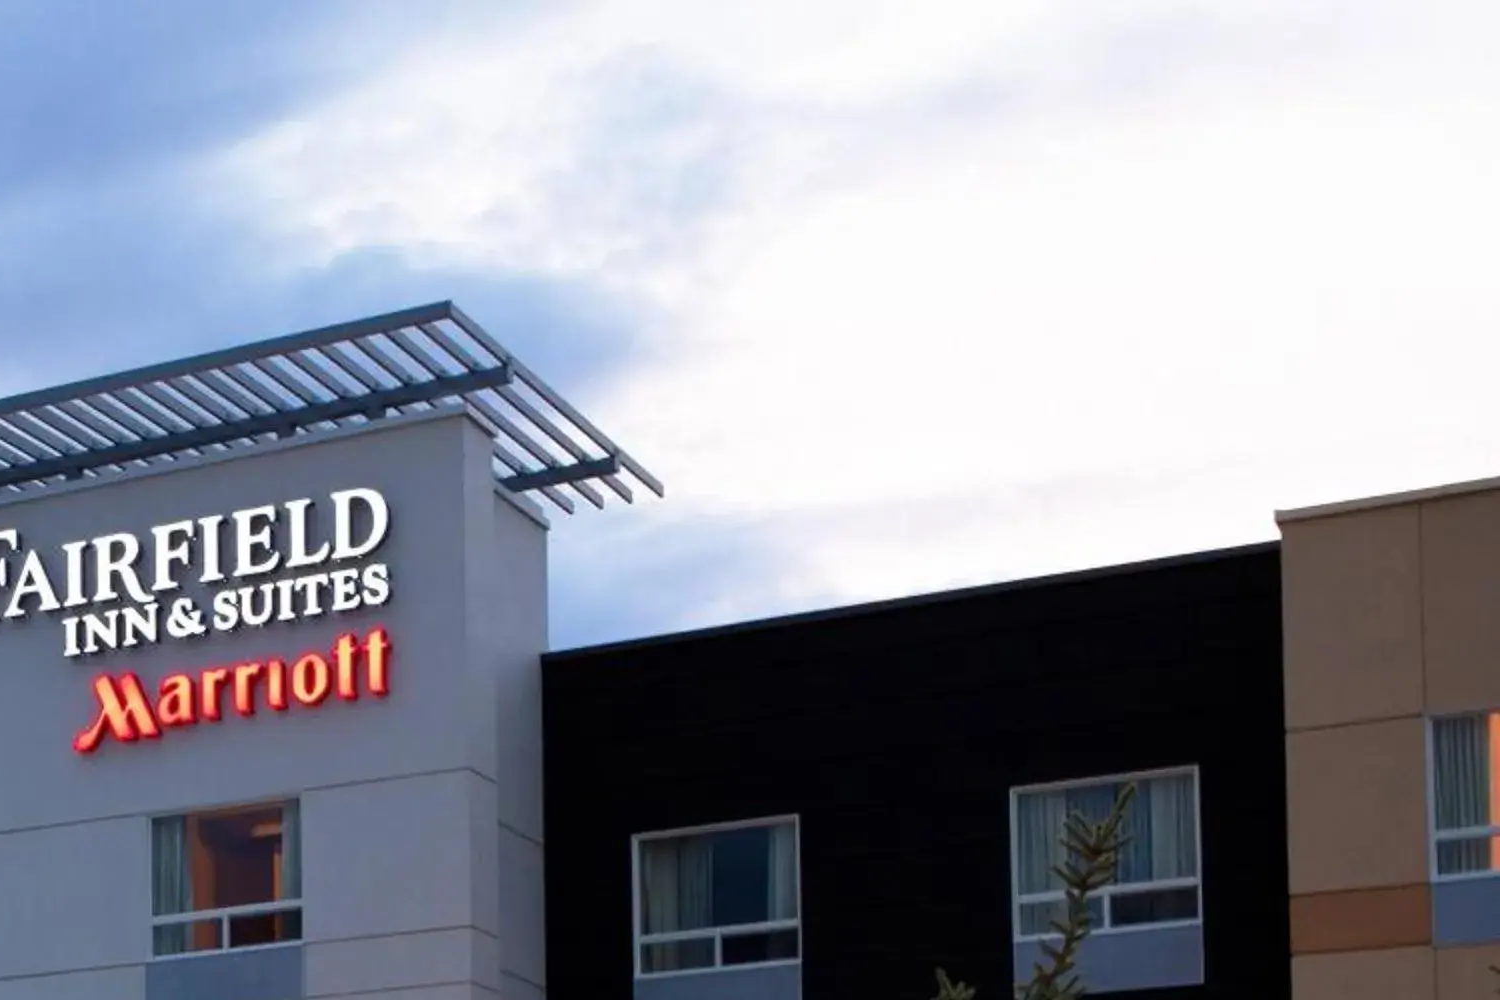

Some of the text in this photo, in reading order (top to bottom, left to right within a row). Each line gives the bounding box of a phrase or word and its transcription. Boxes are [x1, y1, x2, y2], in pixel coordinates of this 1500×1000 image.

[63, 563, 390, 657] INN & SUITES
[73, 628, 392, 753] Marriott
